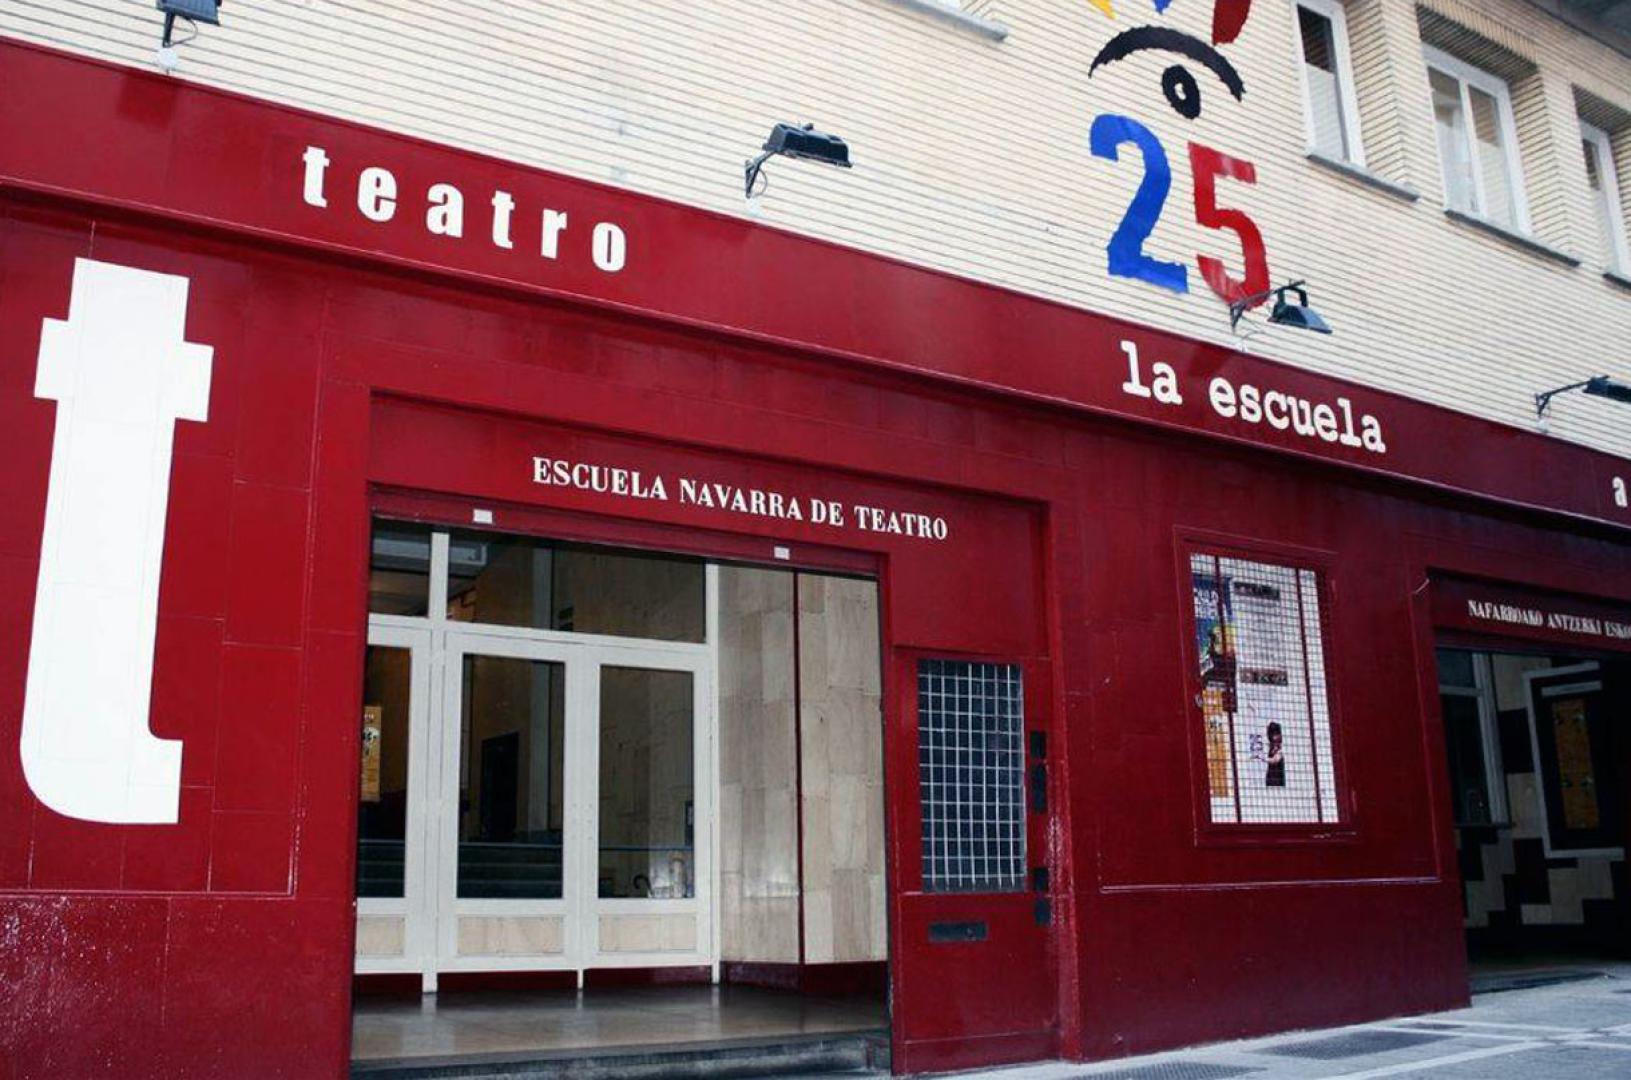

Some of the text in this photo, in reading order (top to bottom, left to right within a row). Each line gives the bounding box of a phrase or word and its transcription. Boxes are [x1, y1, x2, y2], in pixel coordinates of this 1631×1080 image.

[302, 145, 627, 272] teatro
[1090, 114, 1270, 309] 25
[1120, 340, 1387, 453] la escuela
[20, 257, 214, 825] t
[532, 456, 949, 541] ESCUELA NAVARRA DE TEATRO
